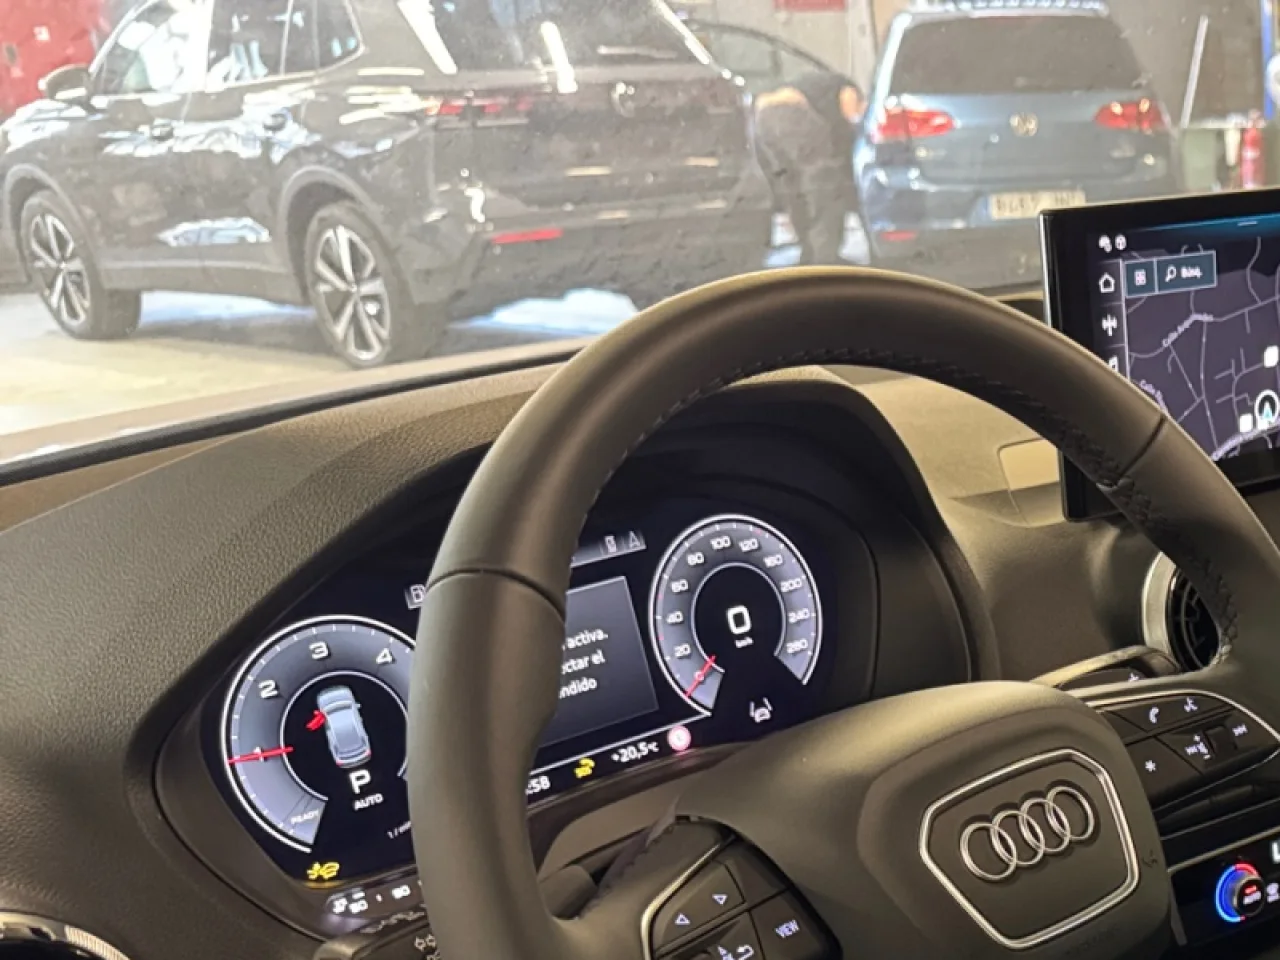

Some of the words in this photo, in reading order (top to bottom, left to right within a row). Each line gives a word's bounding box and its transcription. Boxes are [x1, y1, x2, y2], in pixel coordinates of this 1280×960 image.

[710, 536, 731, 550] 100
[738, 538, 759, 552] 120
[780, 577, 803, 593] 200
[727, 605, 751, 635] 0
[788, 607, 810, 624] 240
[308, 641, 330, 660] 3
[375, 648, 394, 665] 4
[591, 649, 606, 666] el
[674, 643, 692, 658] 20
[258, 679, 279, 699] 2
[350, 769, 372, 795] P
[354, 793, 384, 811] AUTO
[775, 919, 800, 939] VIEW
